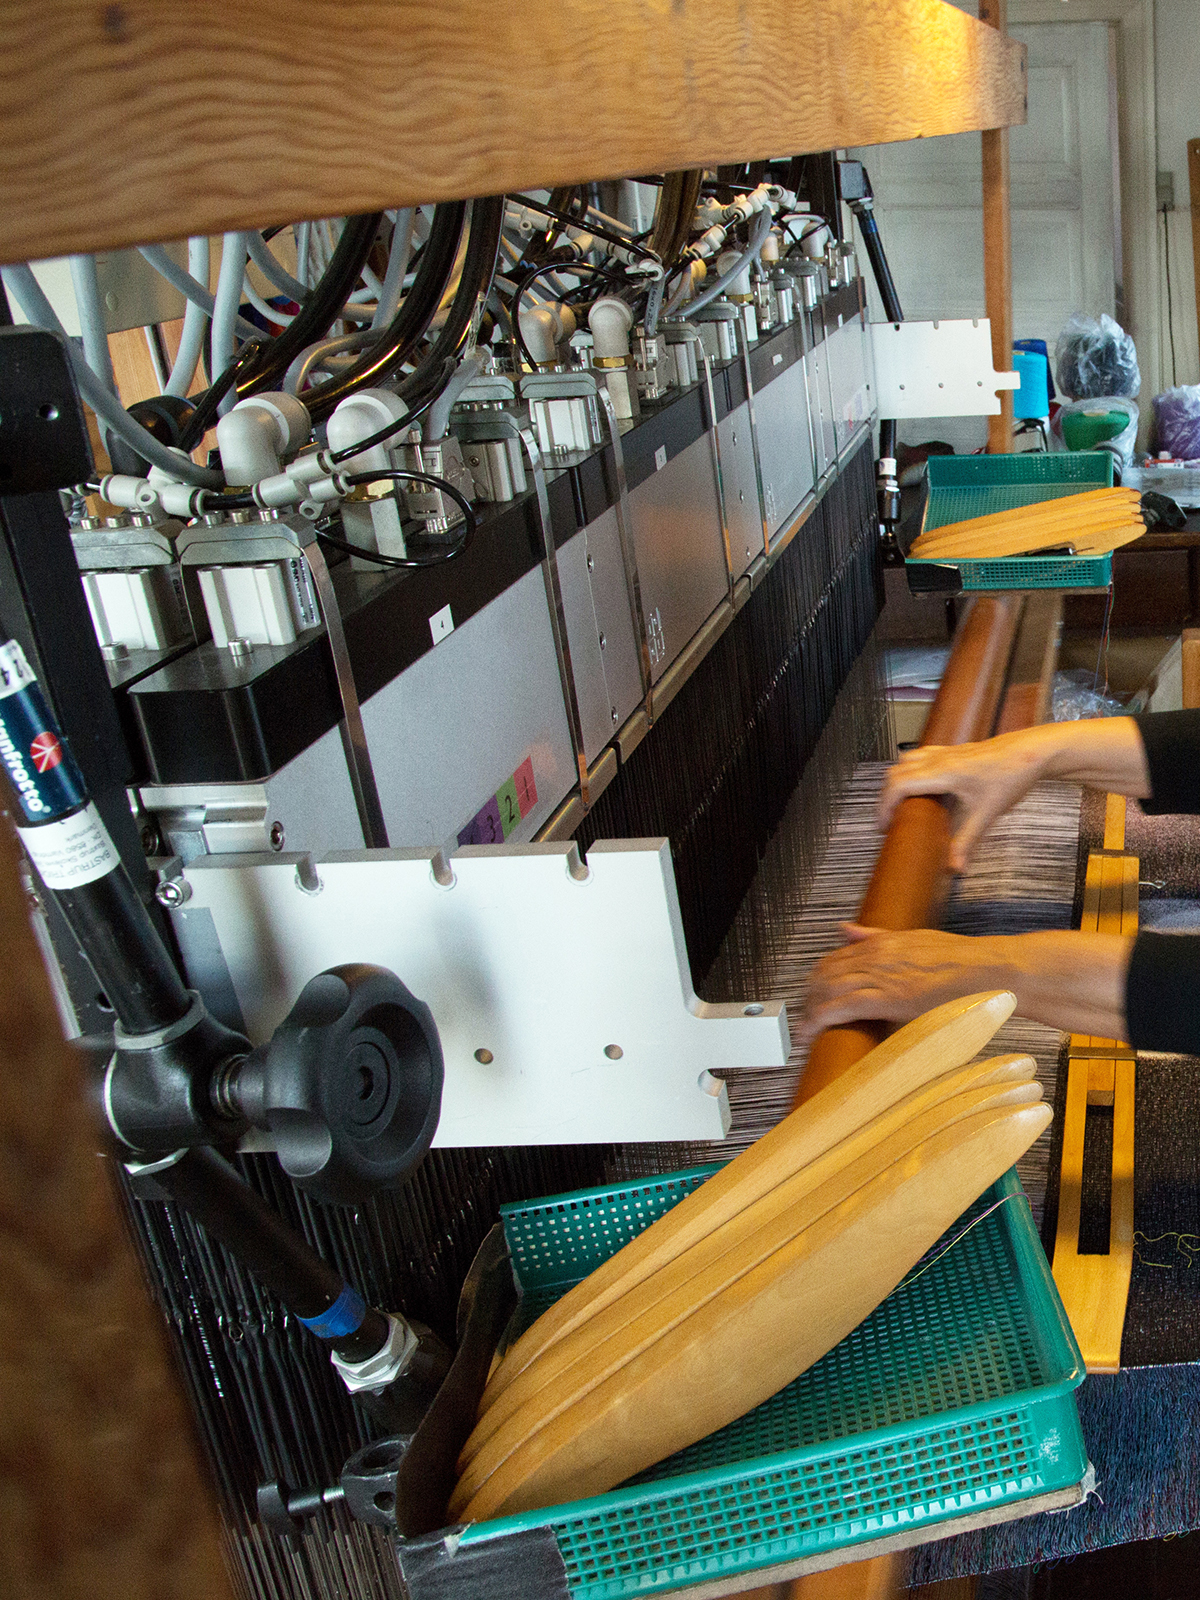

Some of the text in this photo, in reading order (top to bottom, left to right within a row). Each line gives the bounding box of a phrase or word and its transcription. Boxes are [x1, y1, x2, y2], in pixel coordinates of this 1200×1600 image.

[0, 711, 43, 812] anfrotto
[486, 776, 529, 842] 3 2 1
